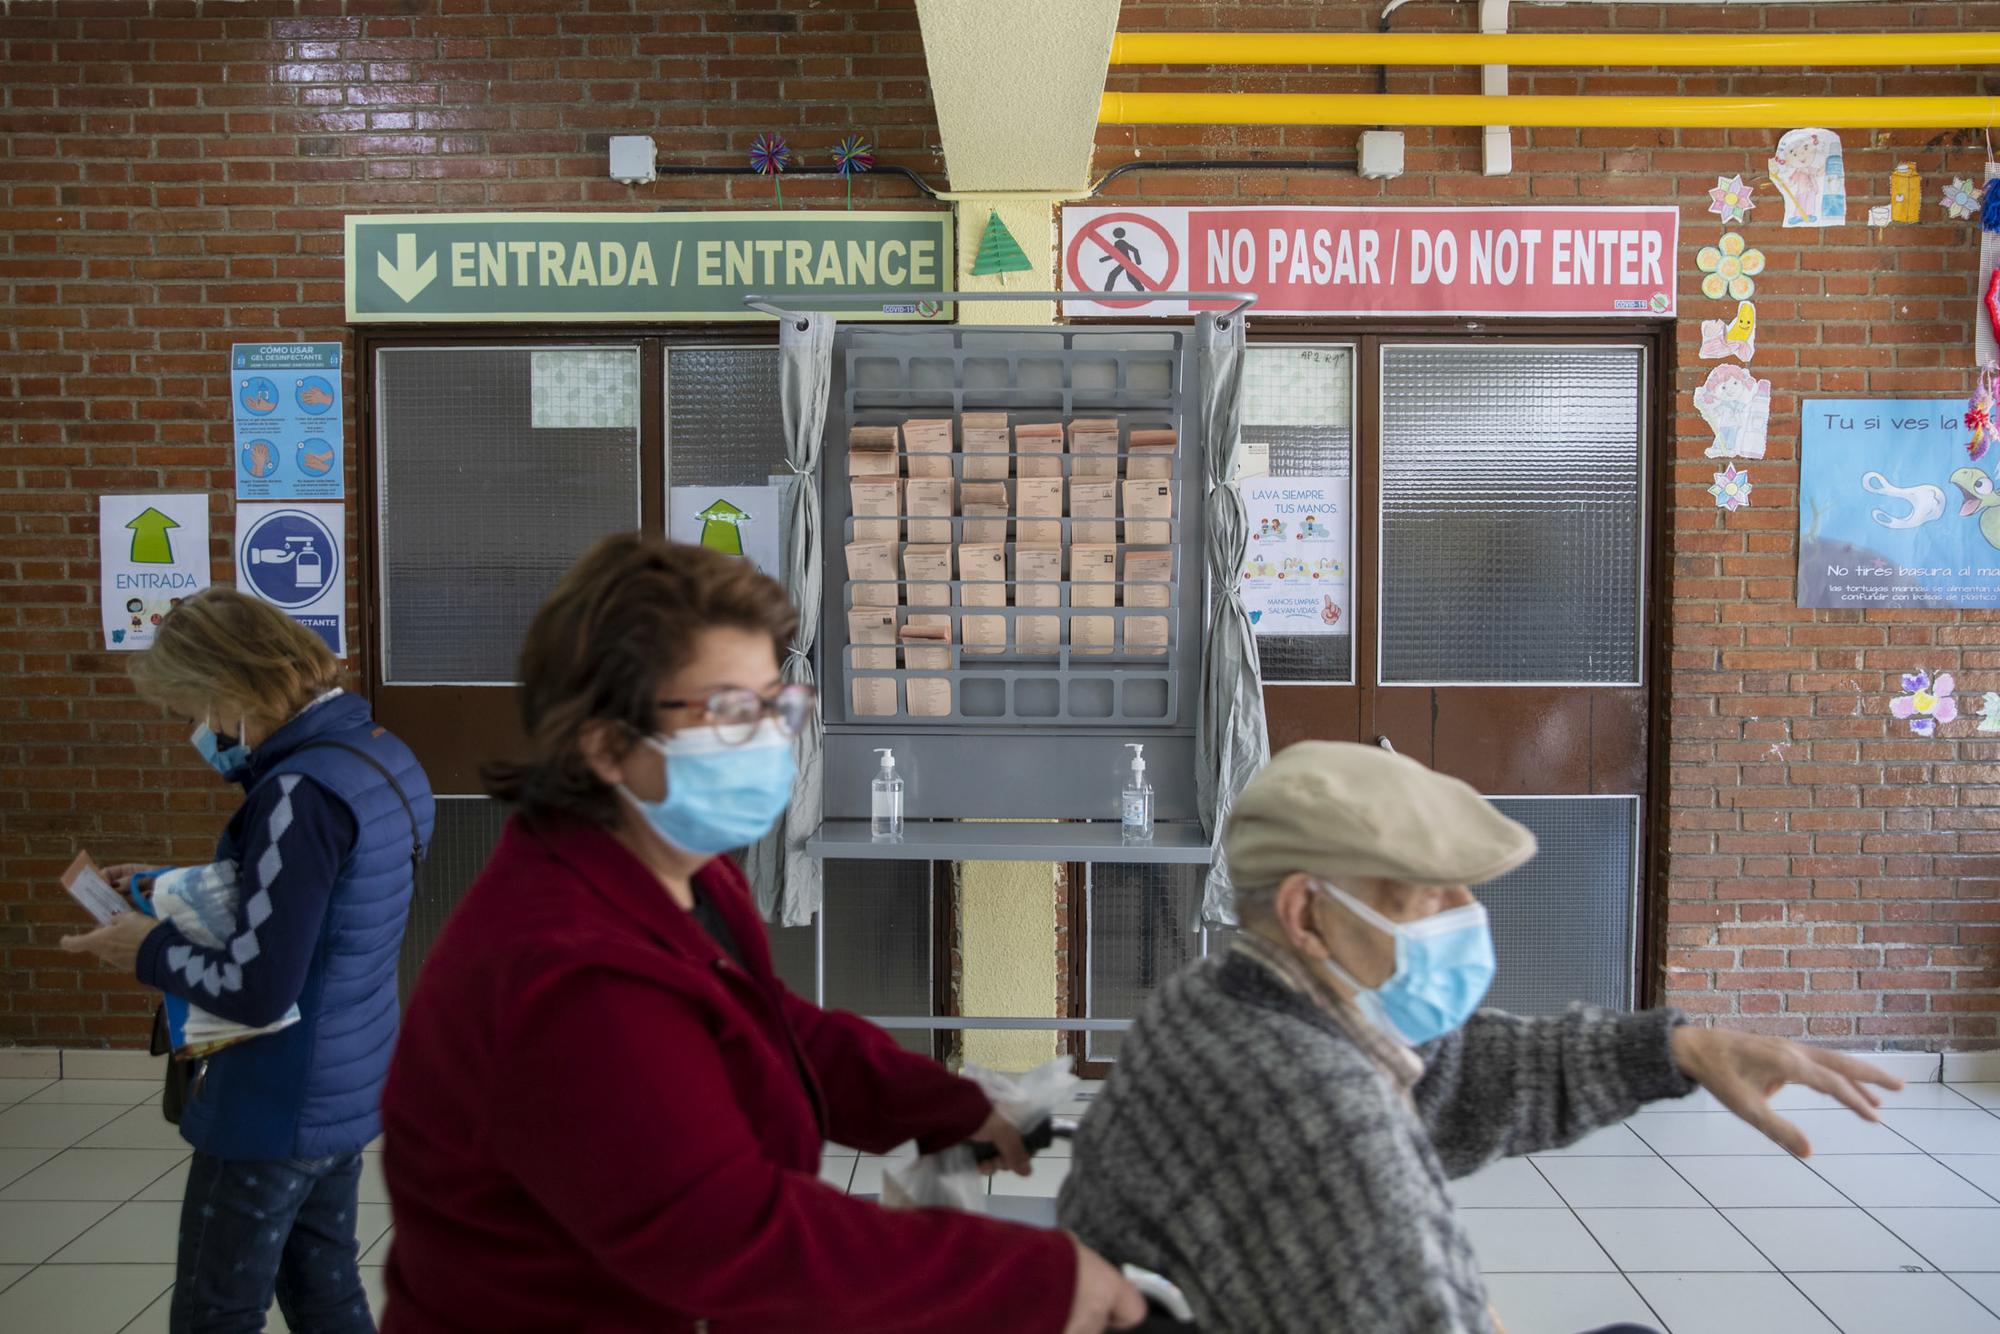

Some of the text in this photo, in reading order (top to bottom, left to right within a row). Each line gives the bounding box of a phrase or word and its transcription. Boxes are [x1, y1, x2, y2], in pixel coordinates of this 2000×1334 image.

[1207, 228, 1664, 286] NO PASAR / DO NOT ENTER
[452, 240, 936, 287] ENTRADA / ENTRANCE
[884, 305, 915, 313] COVID-19
[290, 346, 314, 354] USAR
[1824, 414, 1957, 429] Tu si ves la
[1252, 490, 1324, 500] LAVA SIEMPRE
[1275, 504, 1295, 513] TUS
[1827, 565, 2000, 576] No tires basura al ma
[116, 573, 198, 590] ENTRADA
